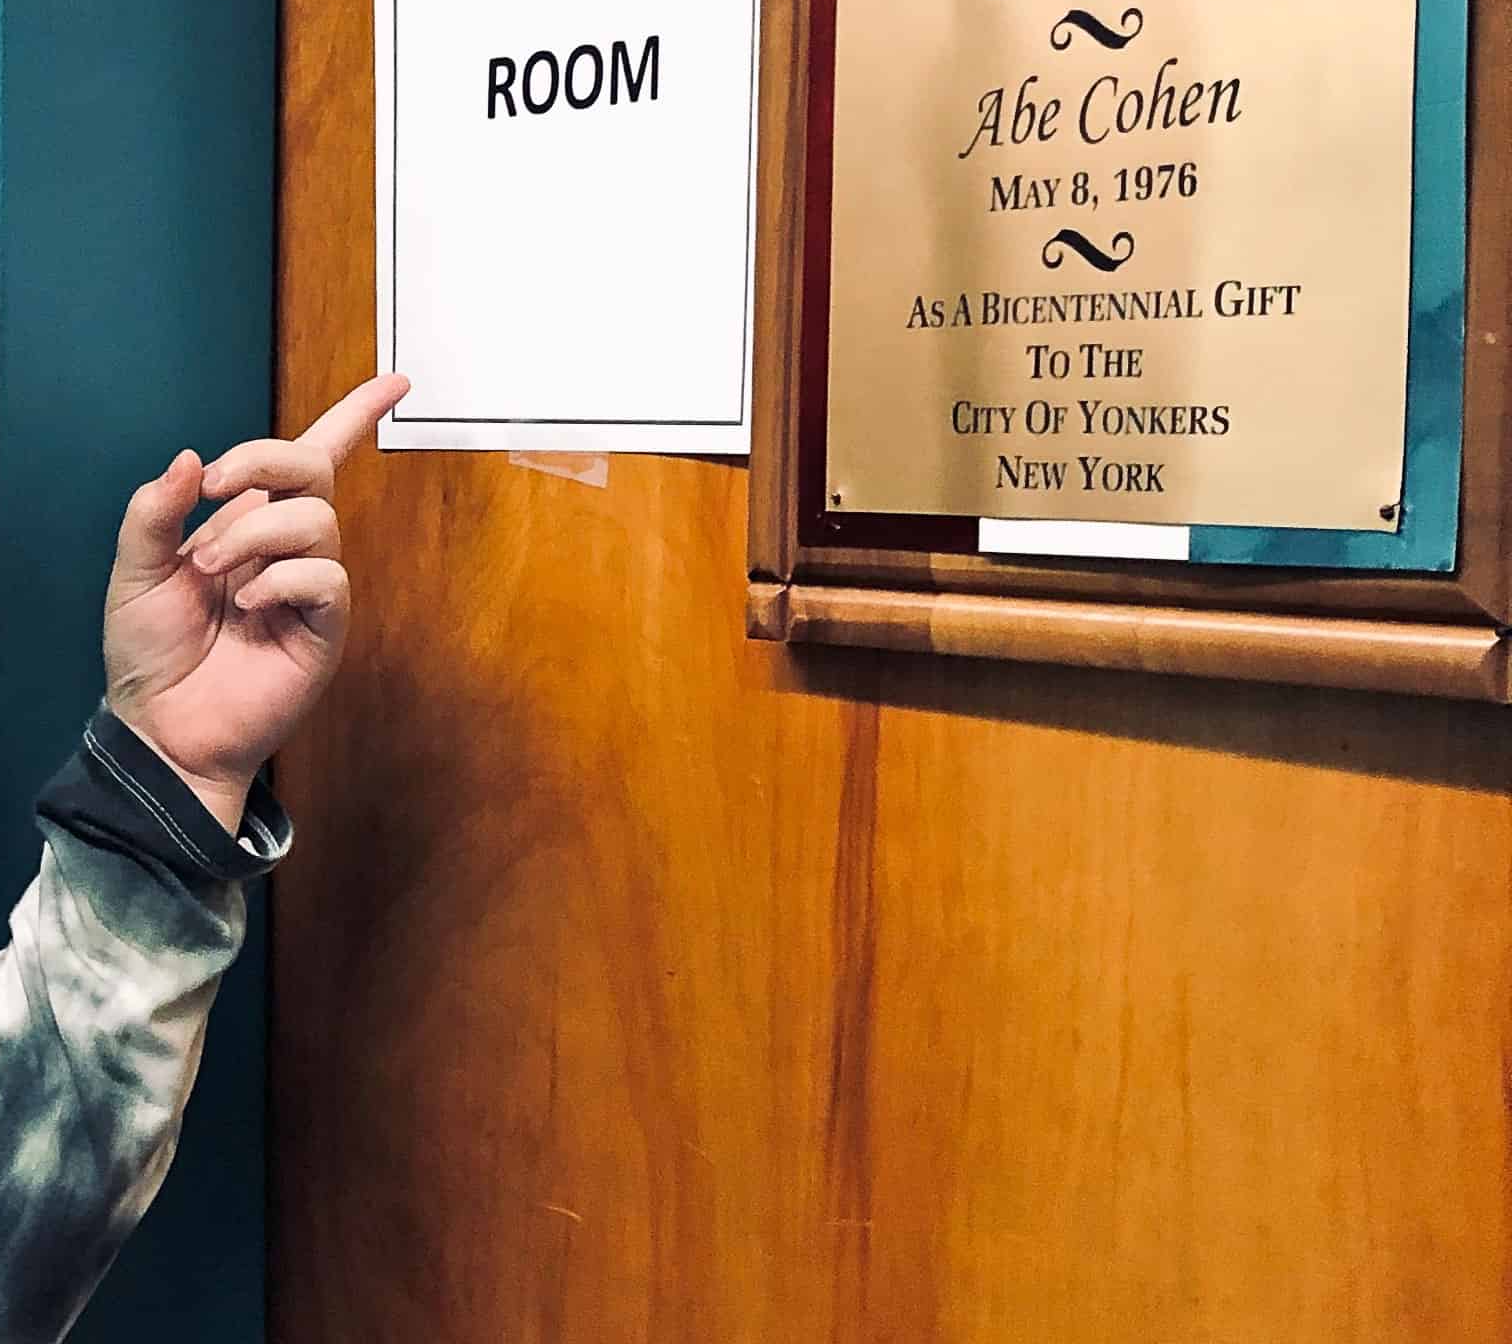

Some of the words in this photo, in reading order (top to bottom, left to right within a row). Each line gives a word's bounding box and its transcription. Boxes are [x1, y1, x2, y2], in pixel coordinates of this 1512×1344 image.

[487, 35, 660, 120] ROOM
[958, 74, 1062, 160] Abe
[1077, 56, 1243, 145] Cohen
[988, 175, 1062, 213] MAY
[1070, 171, 1099, 211] 8,
[1112, 162, 1199, 204] 1976
[905, 295, 945, 329] AS
[950, 295, 974, 327] A
[980, 288, 1204, 327] BICENTENNIAL
[1212, 279, 1302, 319] GIFT
[1025, 344, 1070, 380] TO
[1078, 343, 1144, 379] THE
[951, 399, 1017, 435] CITY
[1024, 399, 1069, 435] OF
[1076, 399, 1231, 436] YONKERS
[994, 455, 1068, 493] NEW
[1076, 455, 1166, 494] YORK
